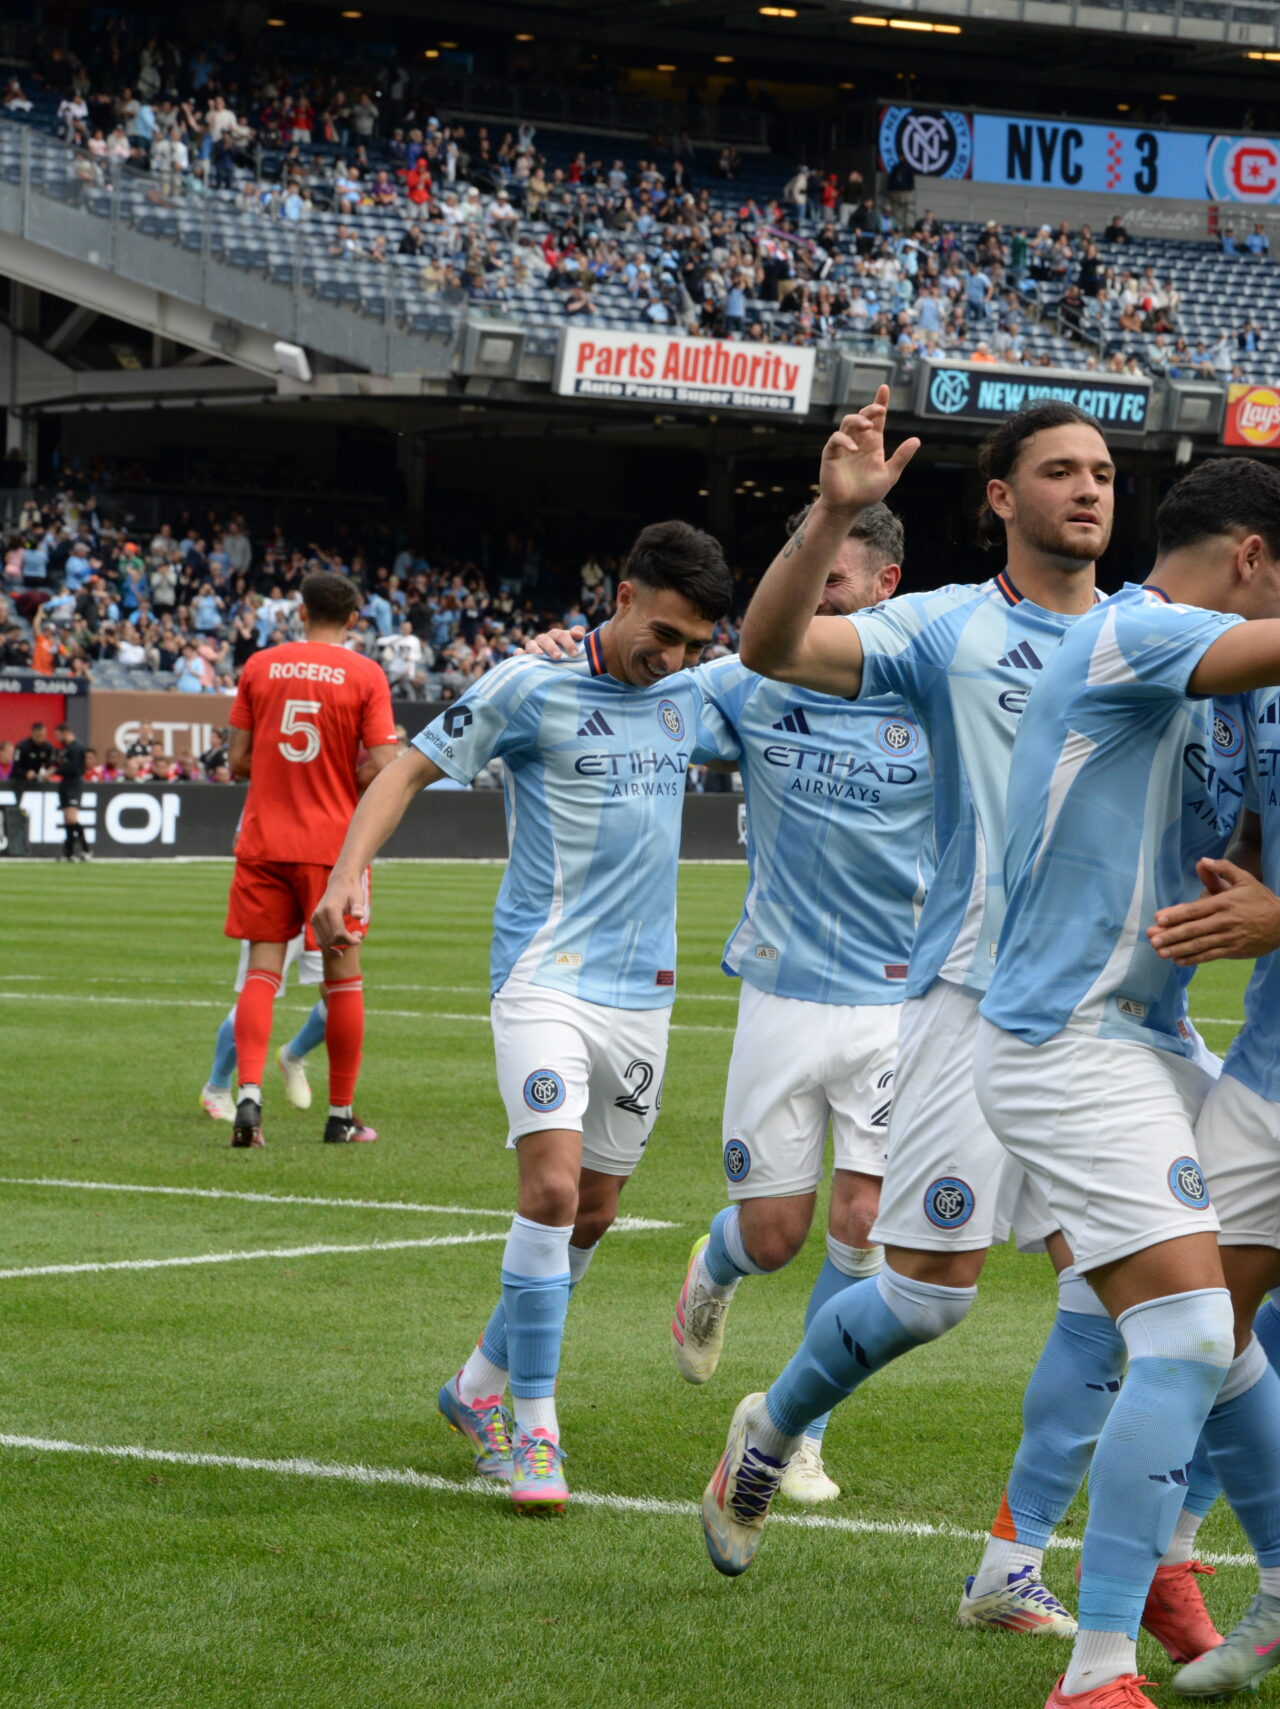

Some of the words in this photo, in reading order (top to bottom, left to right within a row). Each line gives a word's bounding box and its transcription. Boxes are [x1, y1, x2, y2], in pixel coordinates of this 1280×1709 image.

[1007, 123, 1084, 186] NYC
[1134, 132, 1158, 194] 3
[576, 341, 656, 379] Parts
[661, 342, 799, 391] Authority
[579, 381, 624, 396] Auto
[625, 384, 674, 400] Parts
[676, 388, 731, 405] Super
[732, 393, 791, 410] Stores
[977, 381, 1027, 412] NEW
[1120, 393, 1146, 422] FC
[269, 663, 347, 685] ROGERS
[278, 700, 322, 764] 5
[763, 745, 918, 785] ETIHAD
[611, 782, 678, 798] AIRWAYS
[791, 778, 881, 804] AIRWAYS
